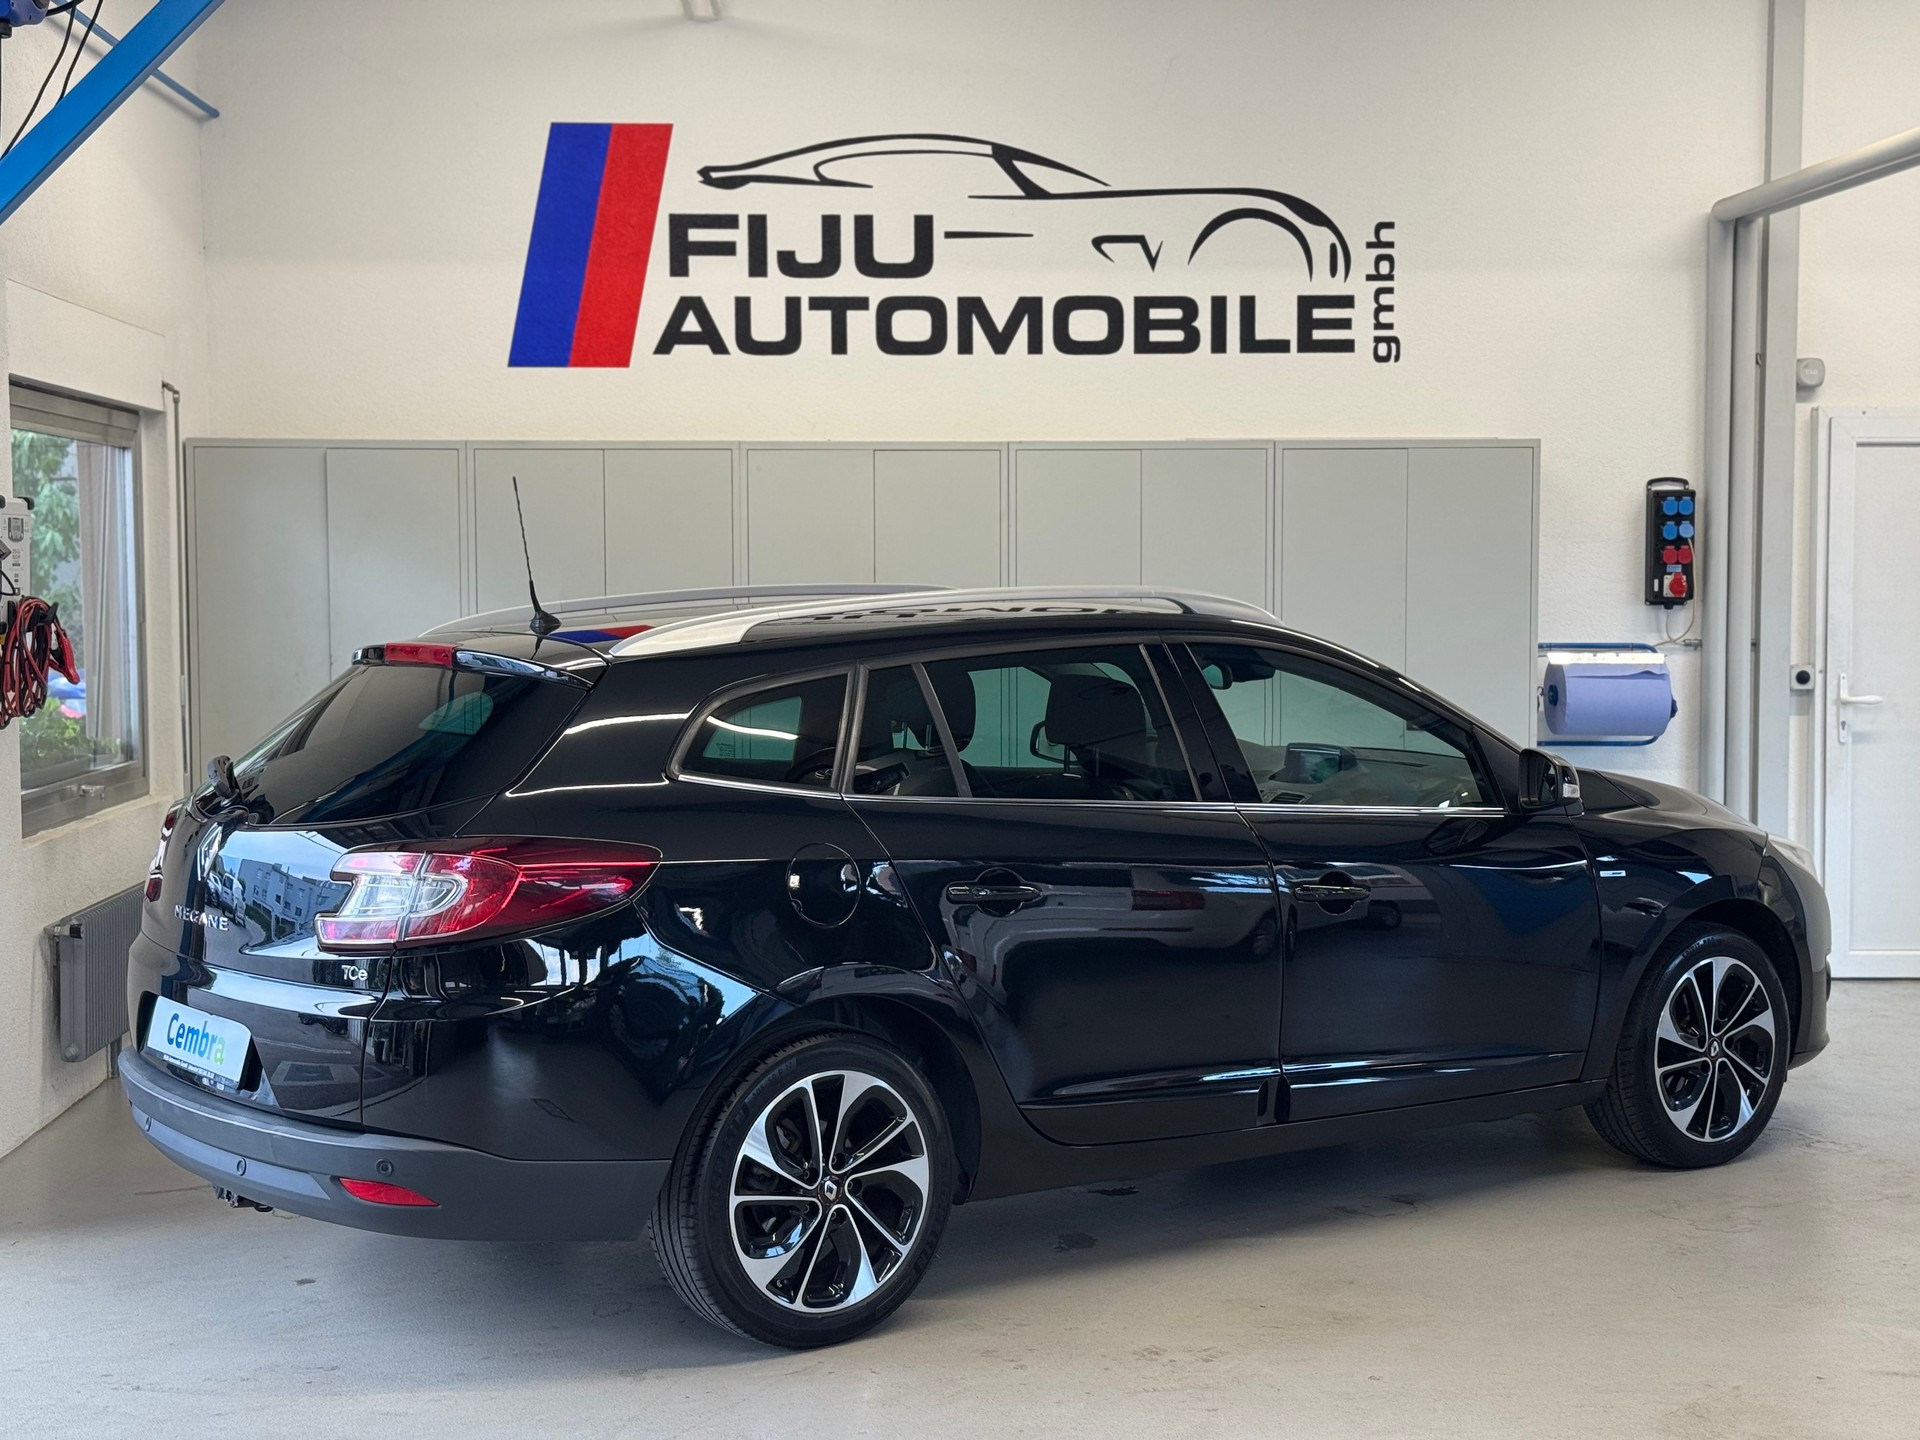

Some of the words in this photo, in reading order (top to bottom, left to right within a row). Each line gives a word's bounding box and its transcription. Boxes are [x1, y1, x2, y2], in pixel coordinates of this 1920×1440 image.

[669, 214, 933, 279] FIJU
[1365, 221, 1400, 363] gmbh
[654, 294, 1355, 356] AUTOMOBILE
[174, 904, 229, 932] MEGANE
[167, 1012, 226, 1066] Cembra
